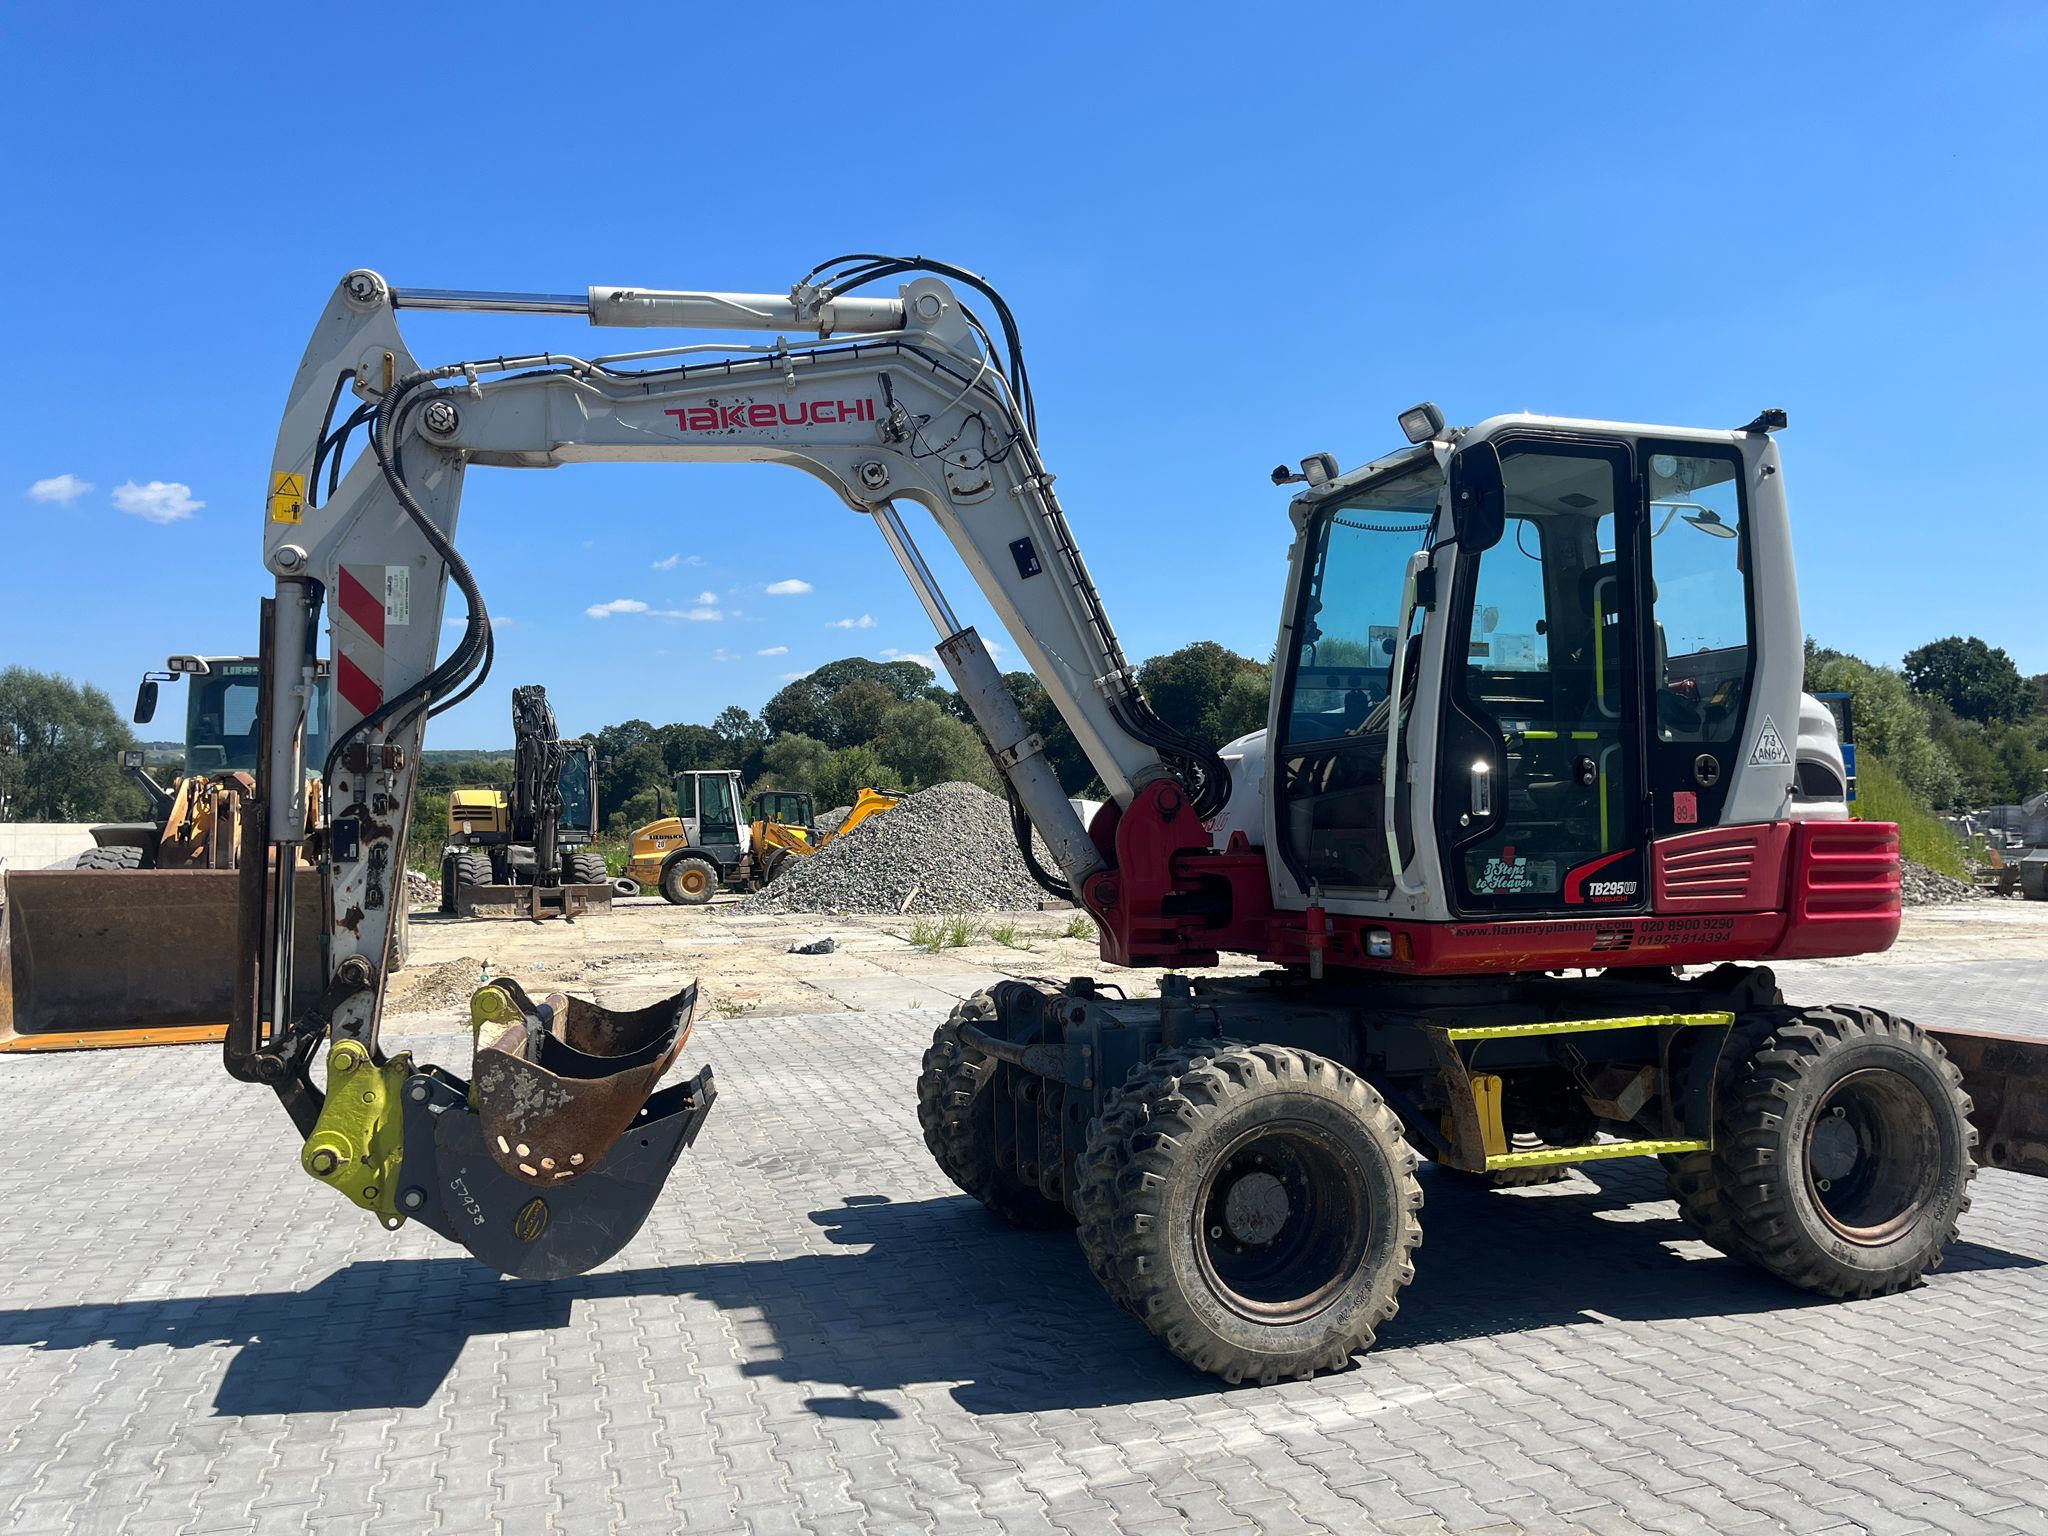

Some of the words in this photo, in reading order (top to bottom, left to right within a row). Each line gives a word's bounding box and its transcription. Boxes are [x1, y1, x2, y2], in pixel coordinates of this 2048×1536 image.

[1763, 735, 1775, 747] 73
[1483, 864, 1492, 875] 3
[1493, 862, 1526, 879] Steps
[1475, 878, 1487, 889] to
[1488, 875, 1534, 888] Heaven
[1589, 881, 1637, 896] TB295W
[1641, 920, 1664, 933] 020
[1667, 919, 1700, 931] 8900
[1703, 918, 1735, 930] 9290
[1637, 933, 1679, 945] 01925
[1681, 931, 1731, 944] 814394
[450, 1177, 486, 1226] 57938
